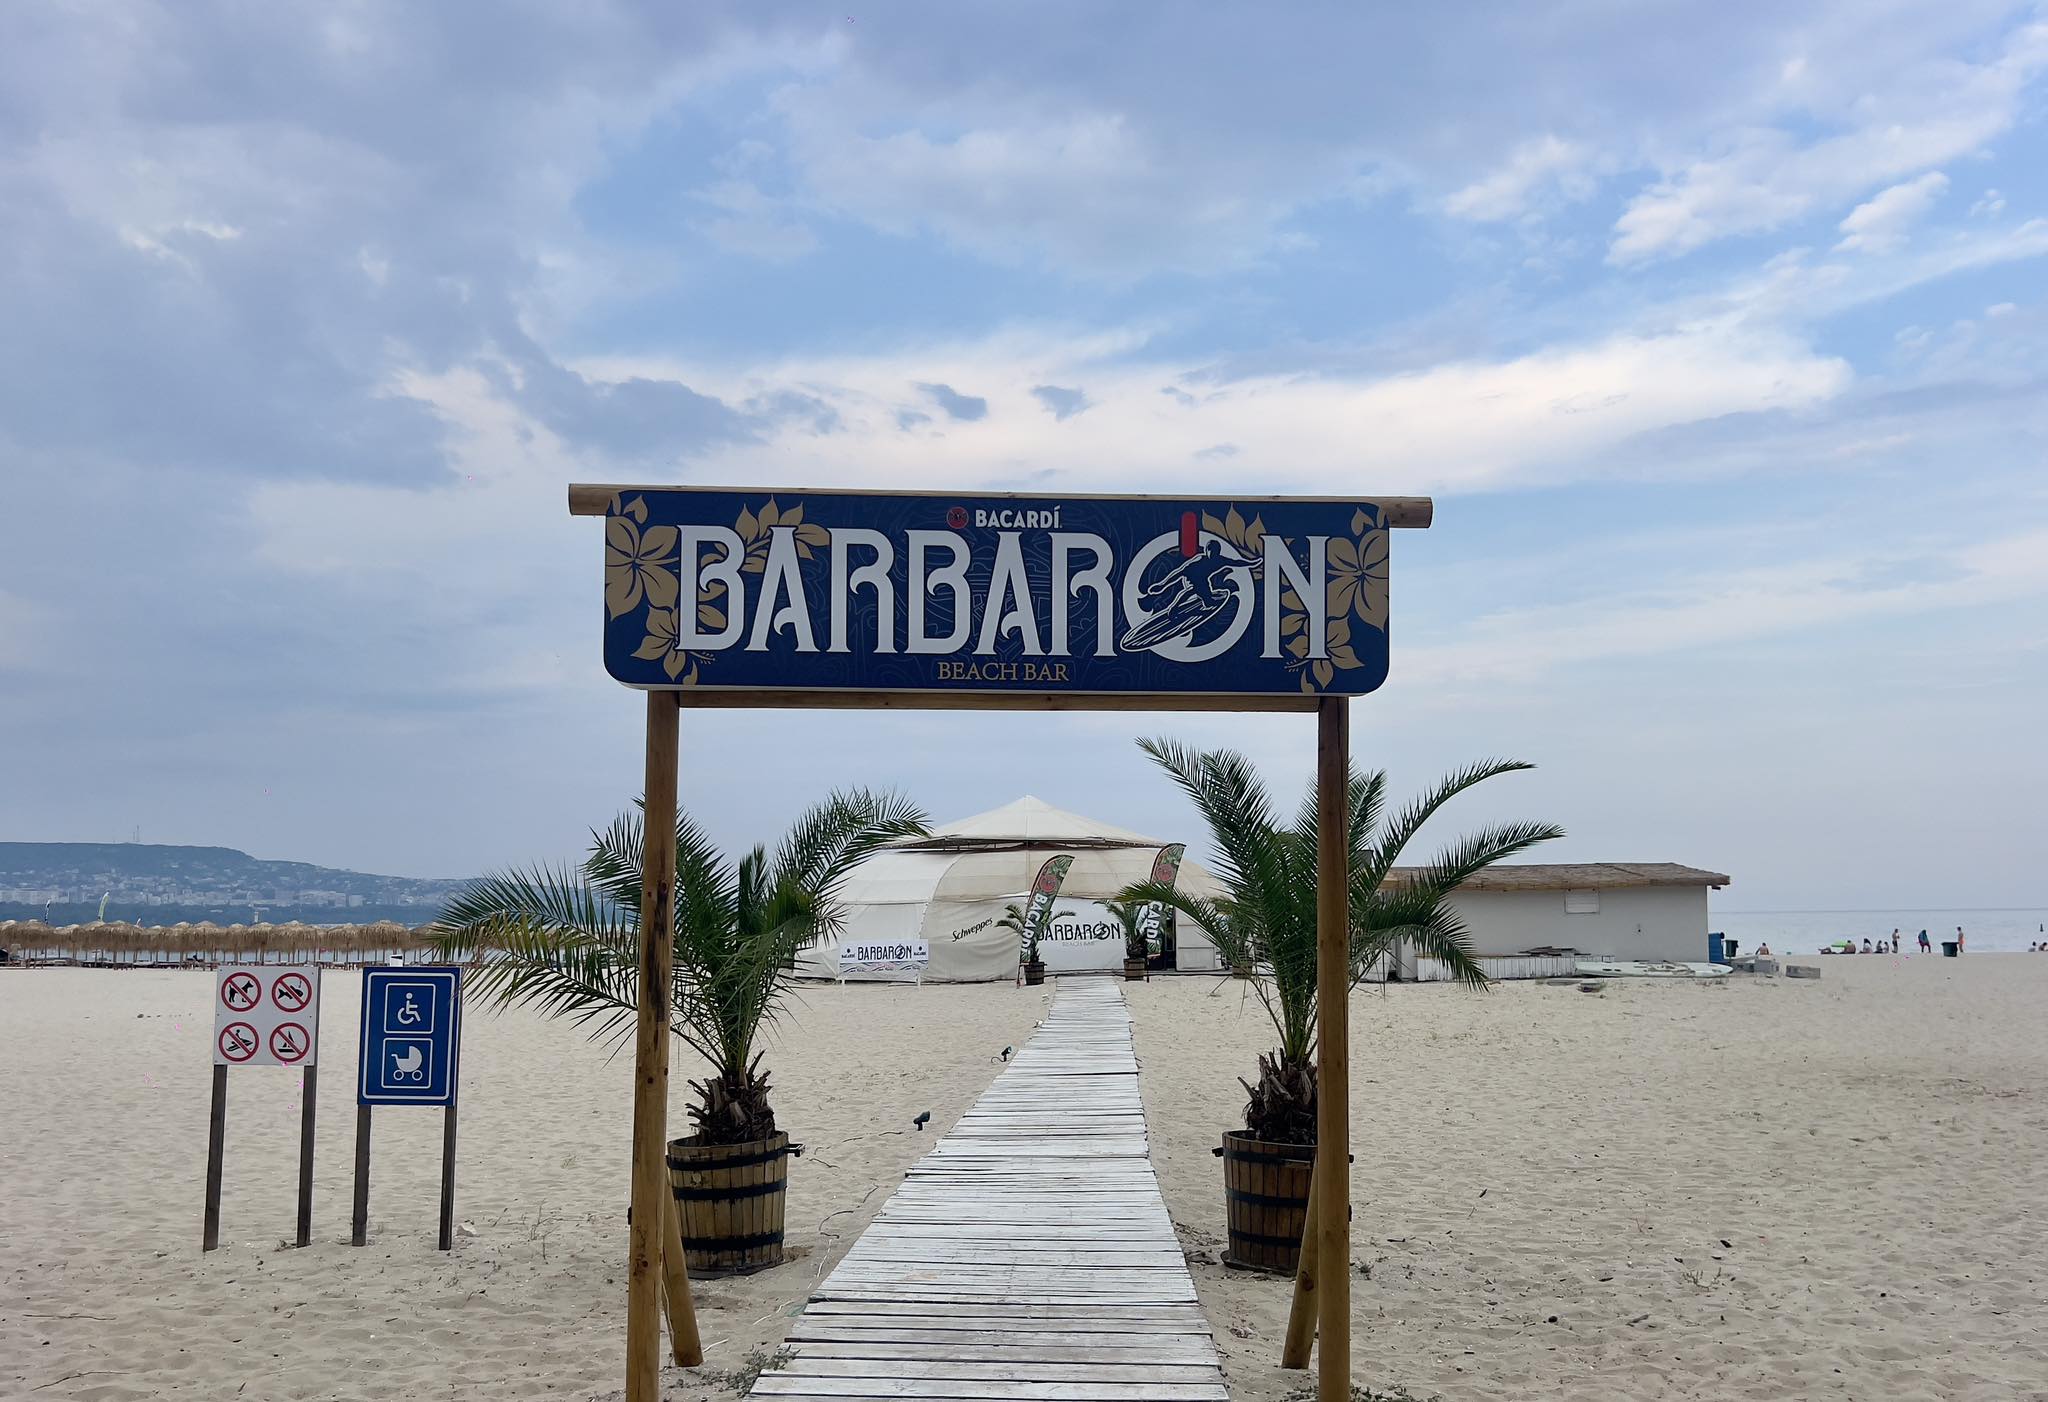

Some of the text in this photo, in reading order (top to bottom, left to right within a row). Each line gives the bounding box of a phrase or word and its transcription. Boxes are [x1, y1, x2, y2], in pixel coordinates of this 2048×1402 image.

[675, 522, 1331, 663] BARBARON
[937, 661, 1069, 682] BEACH BAR
[952, 917, 993, 942] Schweppes
[857, 944, 912, 961] BARBARON
